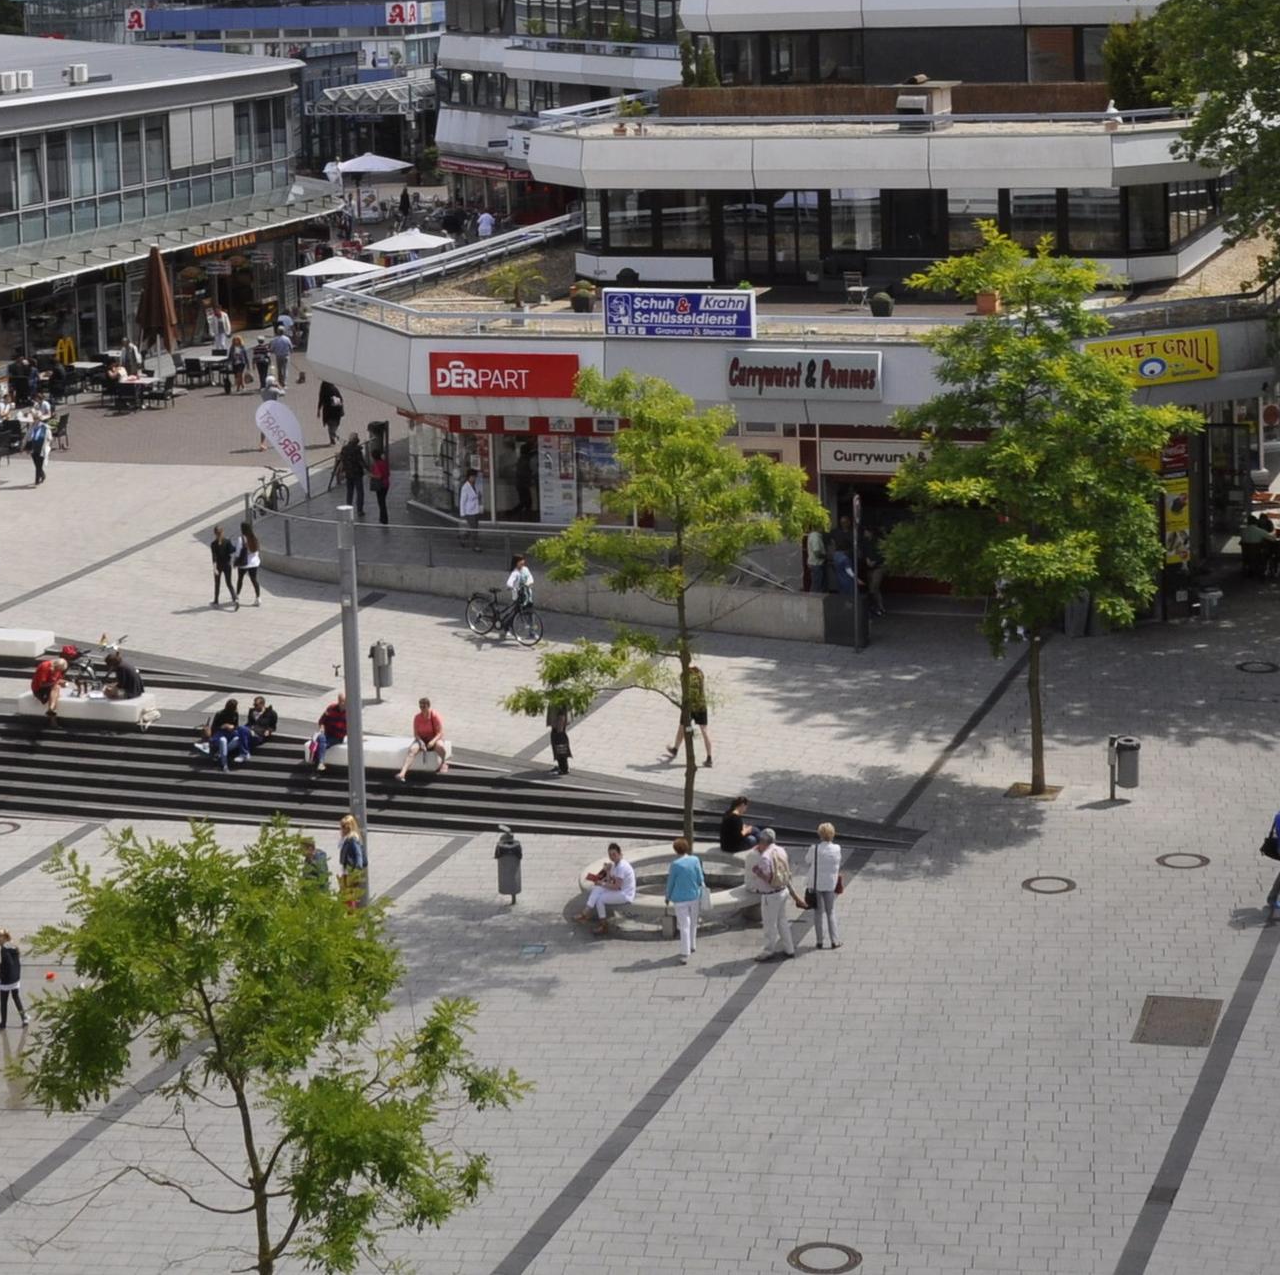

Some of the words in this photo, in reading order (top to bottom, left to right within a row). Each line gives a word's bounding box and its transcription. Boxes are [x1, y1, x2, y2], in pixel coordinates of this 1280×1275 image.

[633, 297, 675, 310] Schuh
[676, 297, 691, 314] &
[703, 296, 746, 310] Krahn
[633, 311, 738, 325] Schlüsseldienst
[1163, 337, 1215, 373] GRILL
[437, 361, 530, 390] DERPART
[729, 357, 803, 396] Currywurst
[804, 359, 817, 389] &
[821, 359, 876, 390] Pommes
